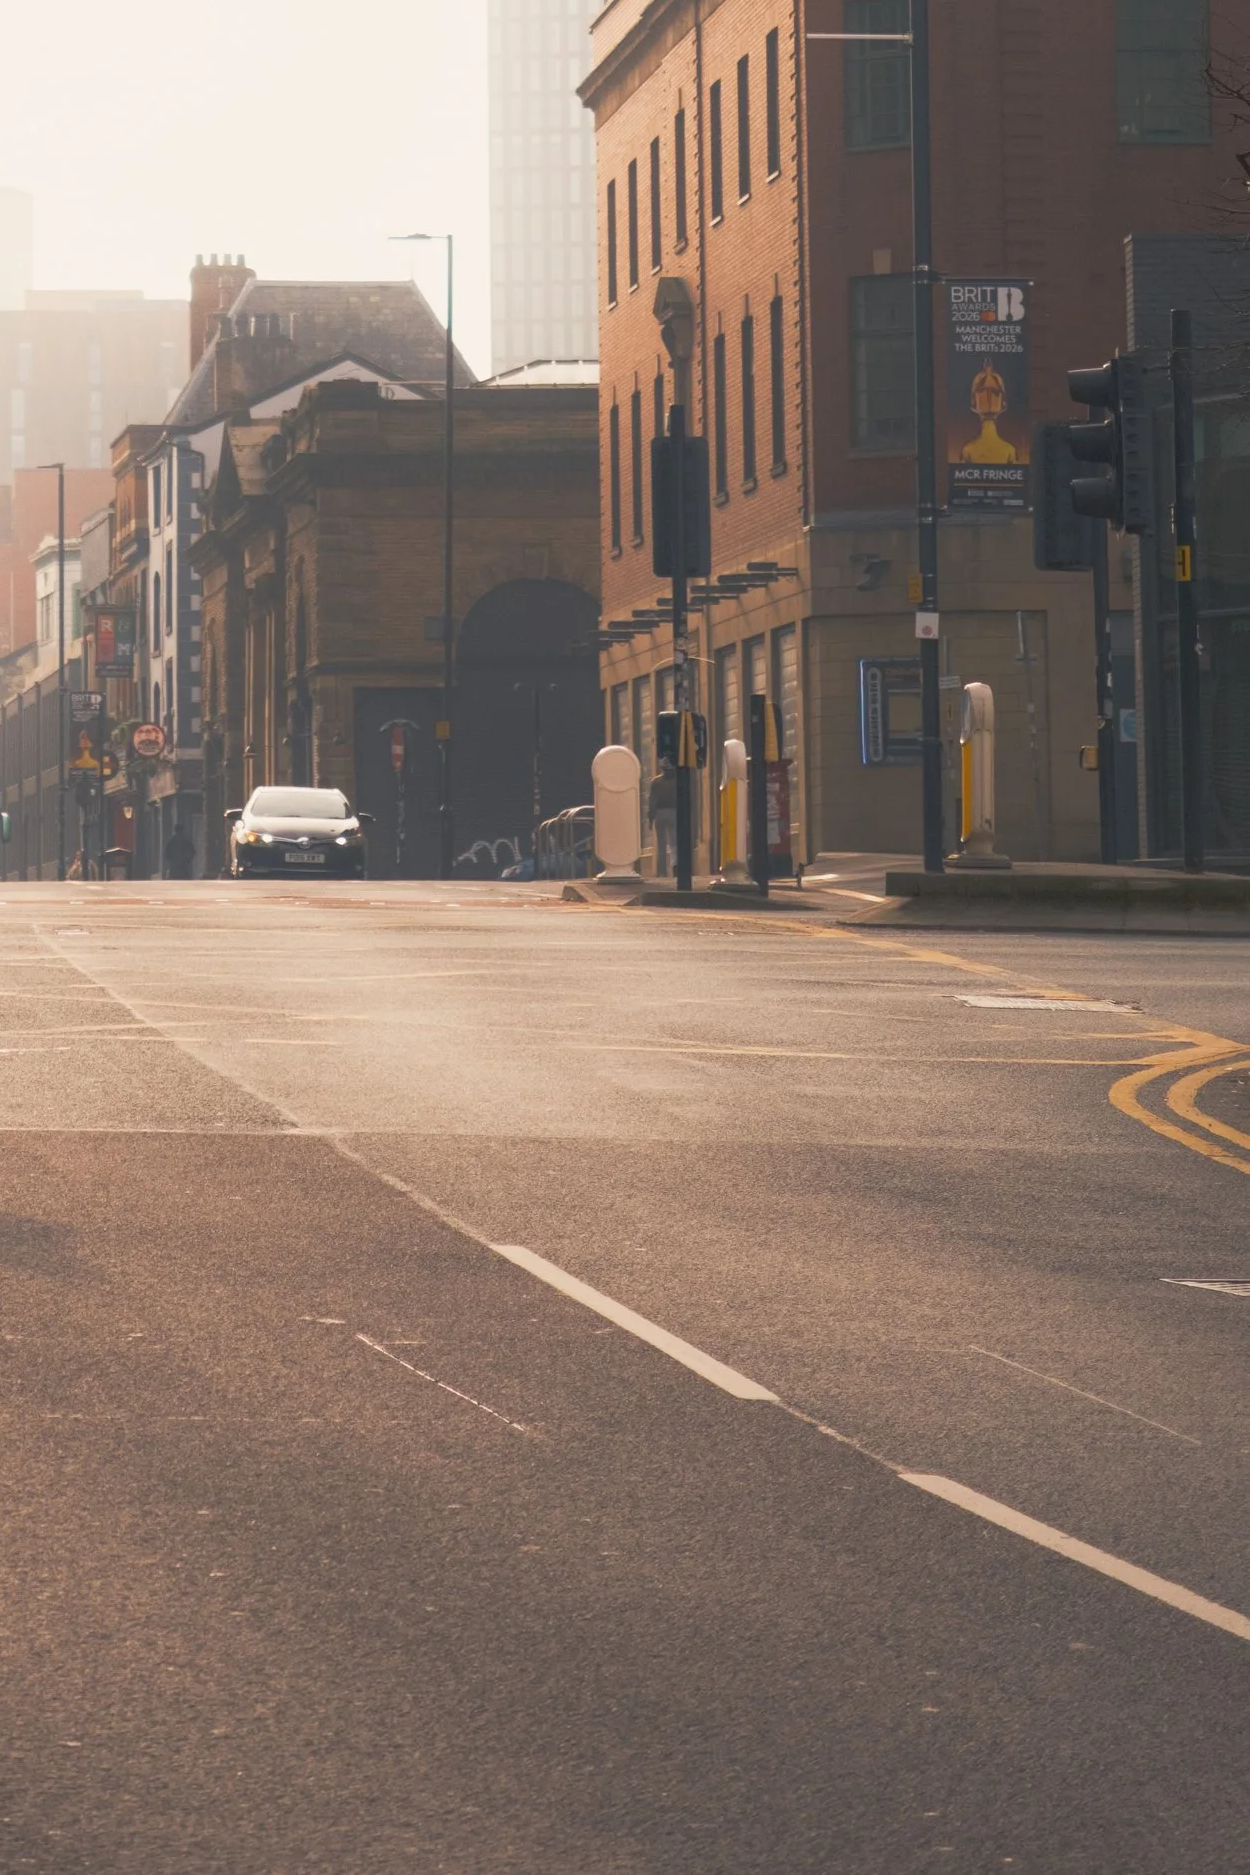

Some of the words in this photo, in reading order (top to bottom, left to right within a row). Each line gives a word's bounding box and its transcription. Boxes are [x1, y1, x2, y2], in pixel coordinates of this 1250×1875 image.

[951, 287, 995, 303] BRIT
[952, 312, 980, 321] 2026
[955, 325, 1022, 334] MANCHESTER
[961, 335, 1016, 343] WELCOMES
[954, 344, 974, 352] THE
[1000, 344, 1023, 353] 2026
[954, 470, 981, 479] MCR
[983, 470, 1023, 480] FRINGE
[118, 643, 131, 655] M
